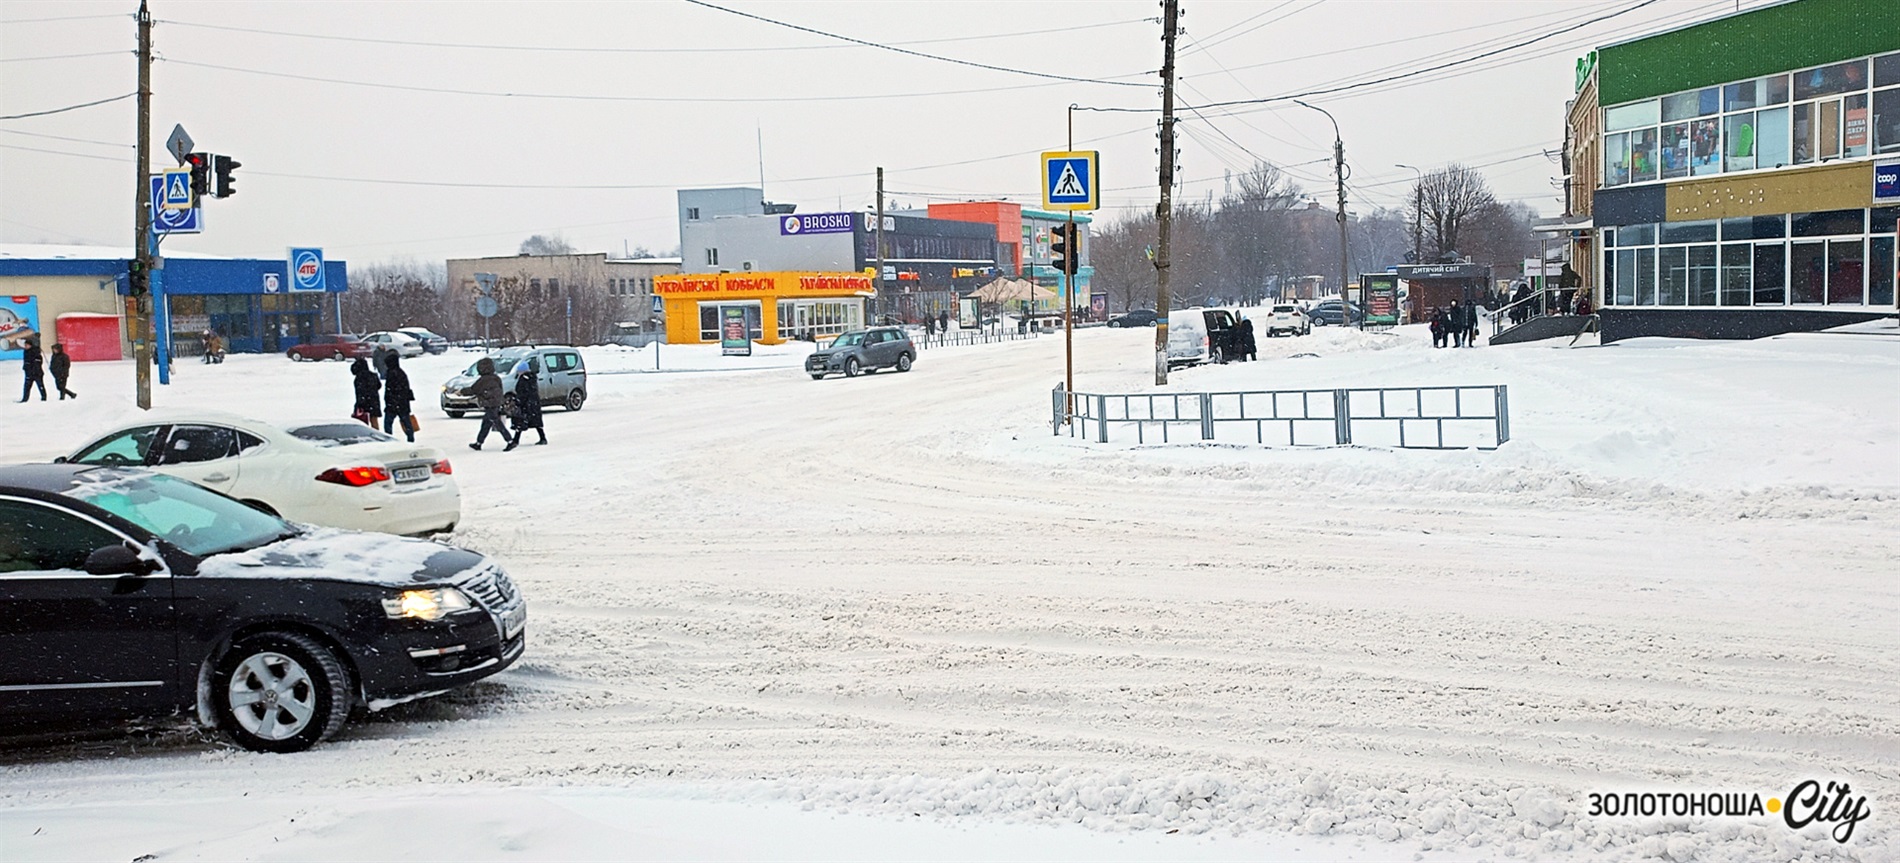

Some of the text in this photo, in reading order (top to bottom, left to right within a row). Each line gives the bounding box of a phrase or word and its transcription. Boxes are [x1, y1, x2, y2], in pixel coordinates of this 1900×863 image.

[1878, 174, 1897, 185] coop
[804, 214, 850, 229] BROSKO
[1412, 264, 1460, 274] ДИТЯЧИЙ СВІТ
[656, 277, 720, 293] УКРАЇНСЬКІ
